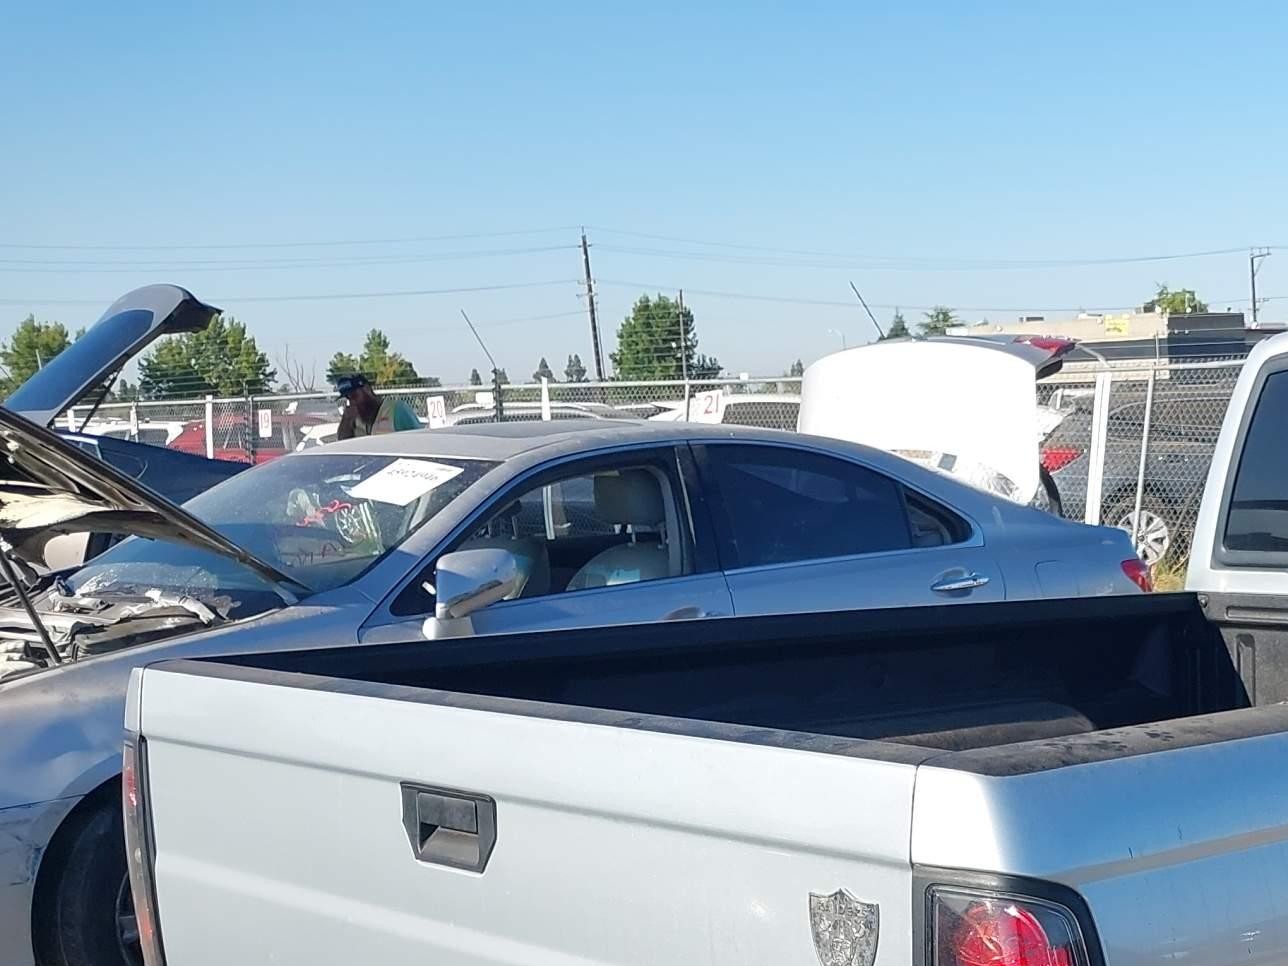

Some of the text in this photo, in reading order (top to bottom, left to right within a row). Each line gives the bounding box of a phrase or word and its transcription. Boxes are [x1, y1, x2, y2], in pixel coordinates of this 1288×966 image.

[430, 400, 443, 418] 20
[703, 393, 719, 414] 21
[260, 412, 270, 429] 19
